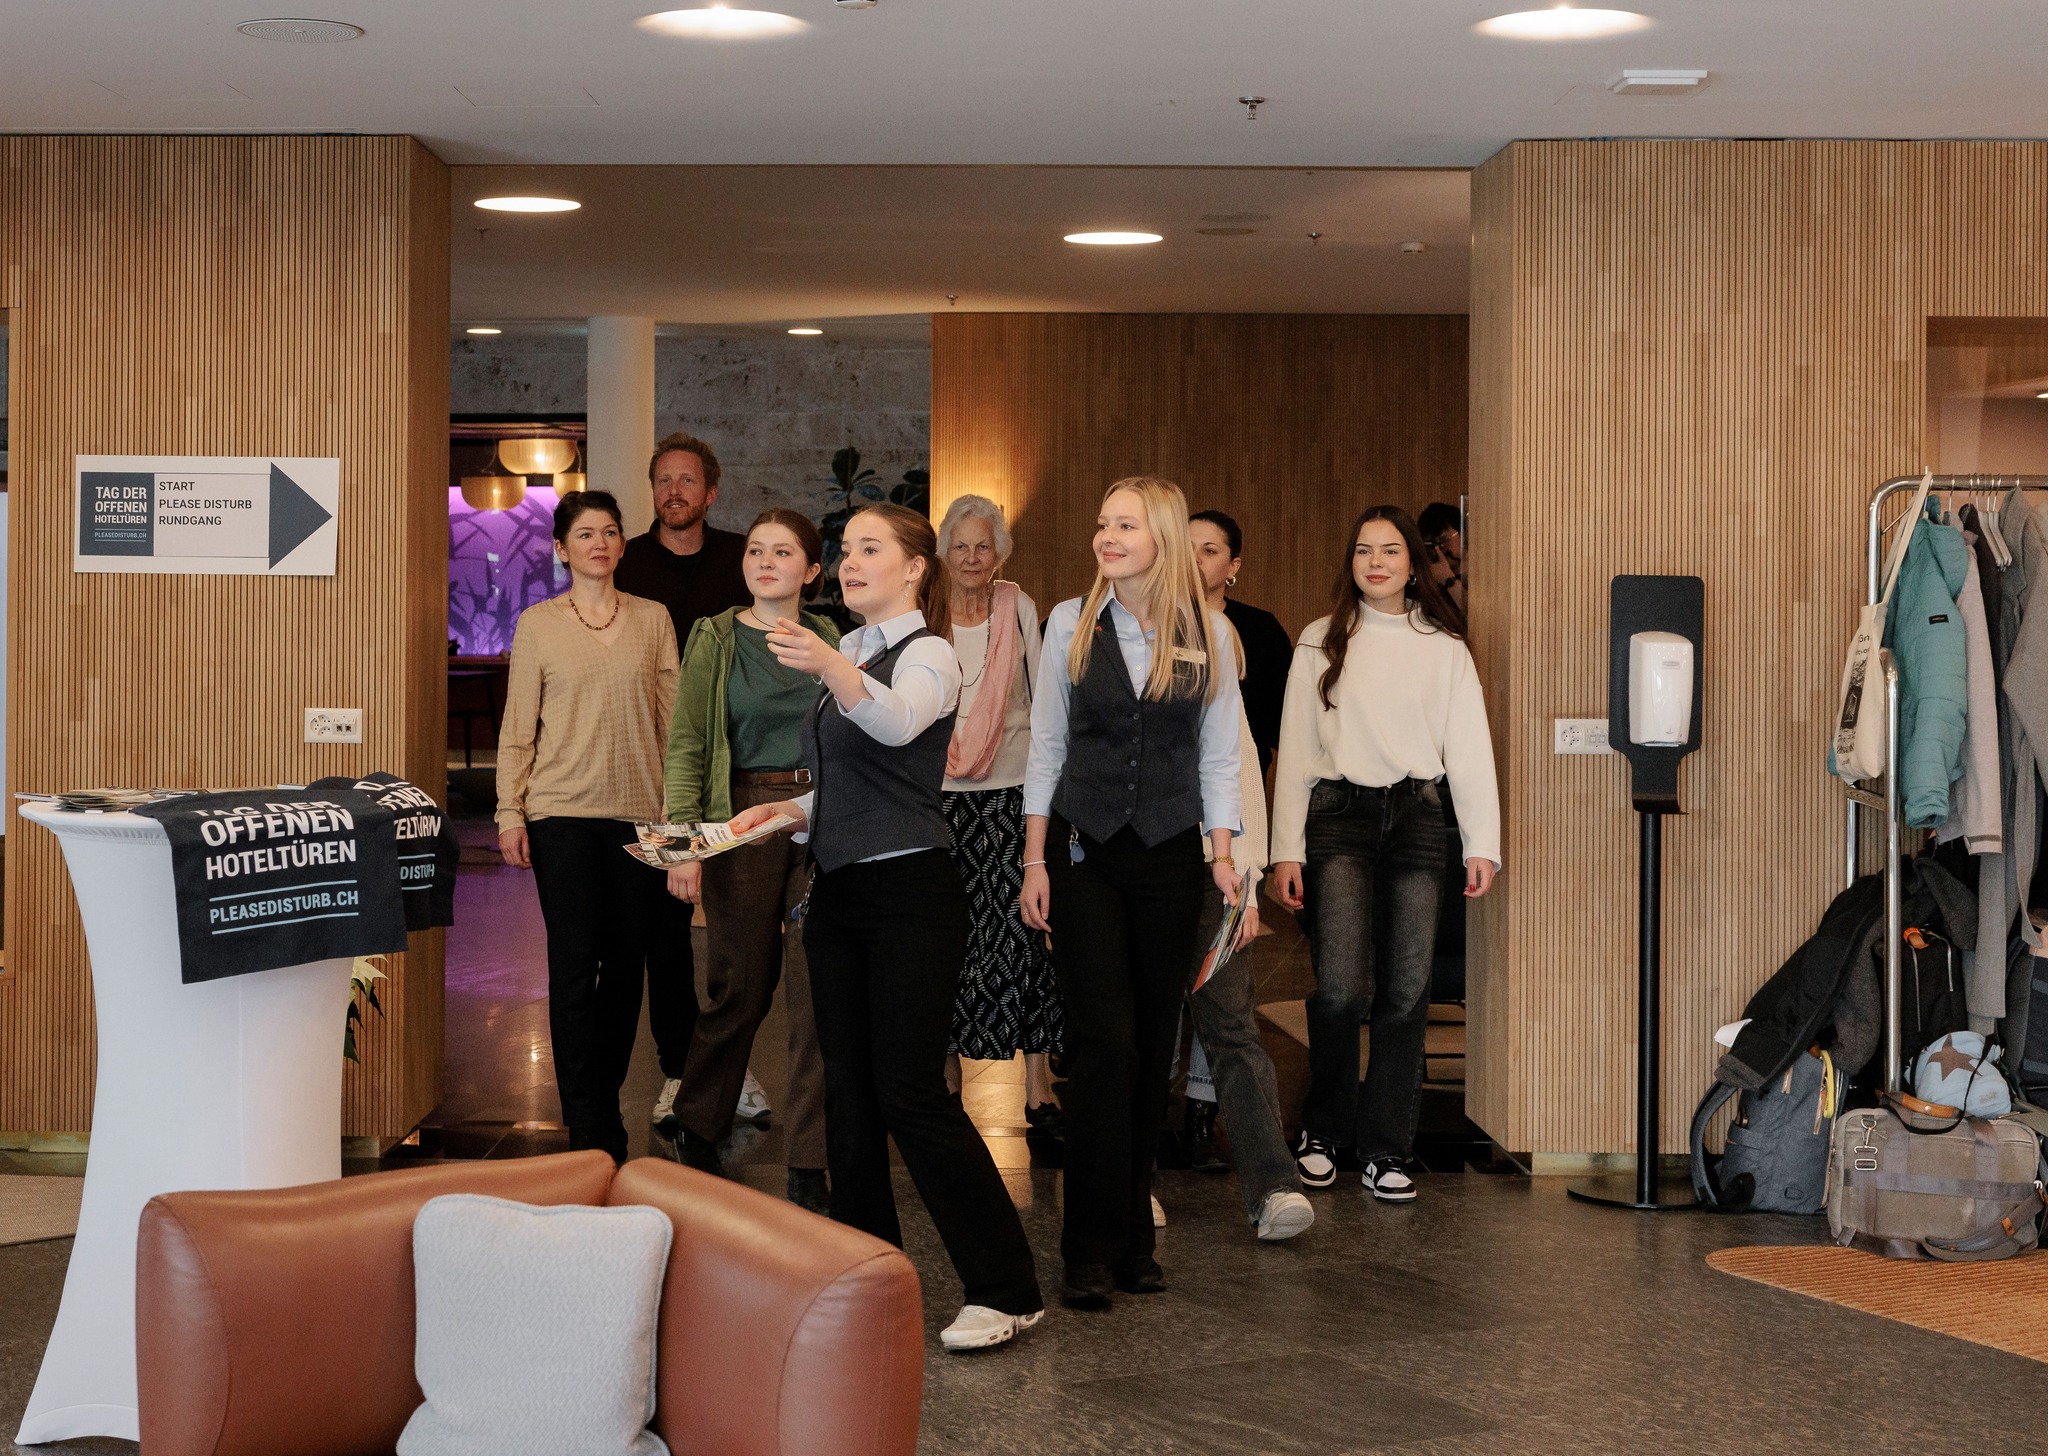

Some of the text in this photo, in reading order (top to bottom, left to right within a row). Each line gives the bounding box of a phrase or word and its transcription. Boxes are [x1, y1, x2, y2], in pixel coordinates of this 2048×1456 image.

[159, 481, 195, 491] START
[95, 486, 147, 499] TAG DER
[95, 501, 147, 513] OFFENEN
[159, 499, 252, 509] PLEASE DISTURB
[94, 513, 147, 524] HOTELTÜREN
[159, 515, 222, 525] RUNDGANG
[94, 531, 147, 539] PLEASEDISTURB.CH
[194, 801, 342, 817] TAG DER
[200, 808, 355, 847] OFFENEN
[205, 839, 357, 881] HOTELTÜREN
[209, 890, 359, 924] PLEASEDISTURB.CH
